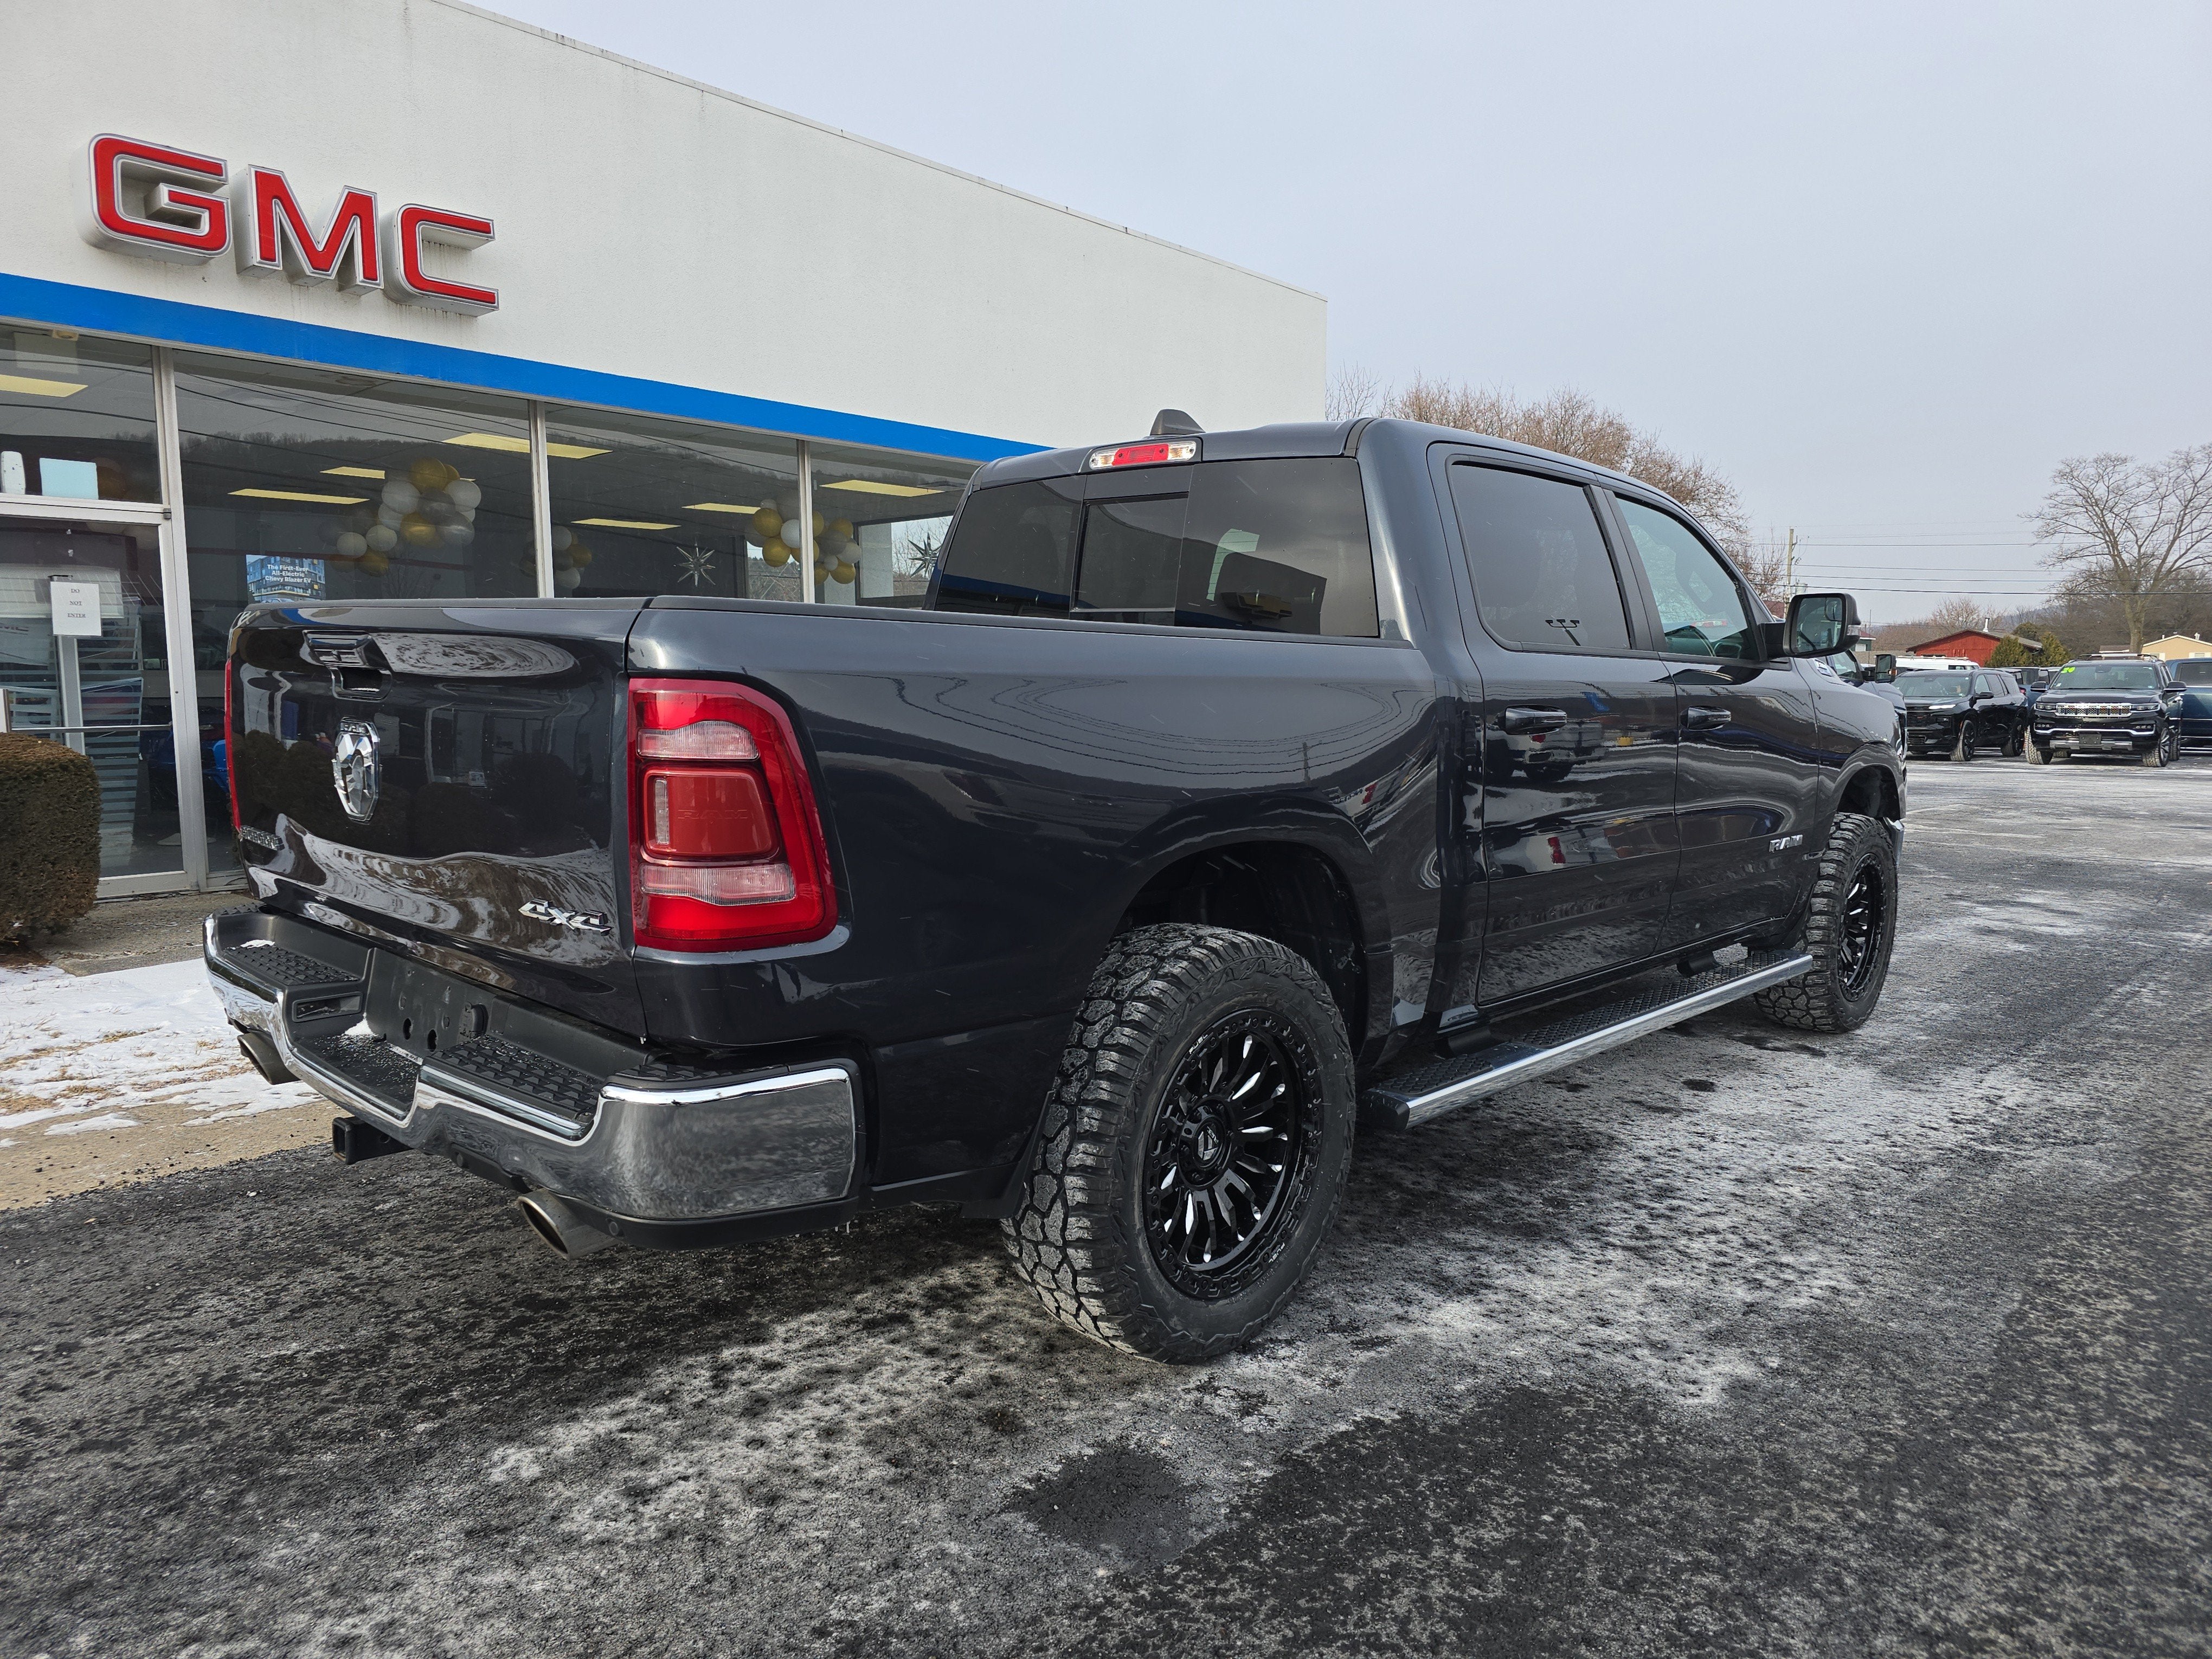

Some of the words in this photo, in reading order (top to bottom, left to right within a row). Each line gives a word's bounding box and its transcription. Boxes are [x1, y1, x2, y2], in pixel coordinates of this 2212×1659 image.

[87, 133, 499, 312] GMC
[678, 809, 748, 819] RAM
[1769, 834, 1803, 853] RAM
